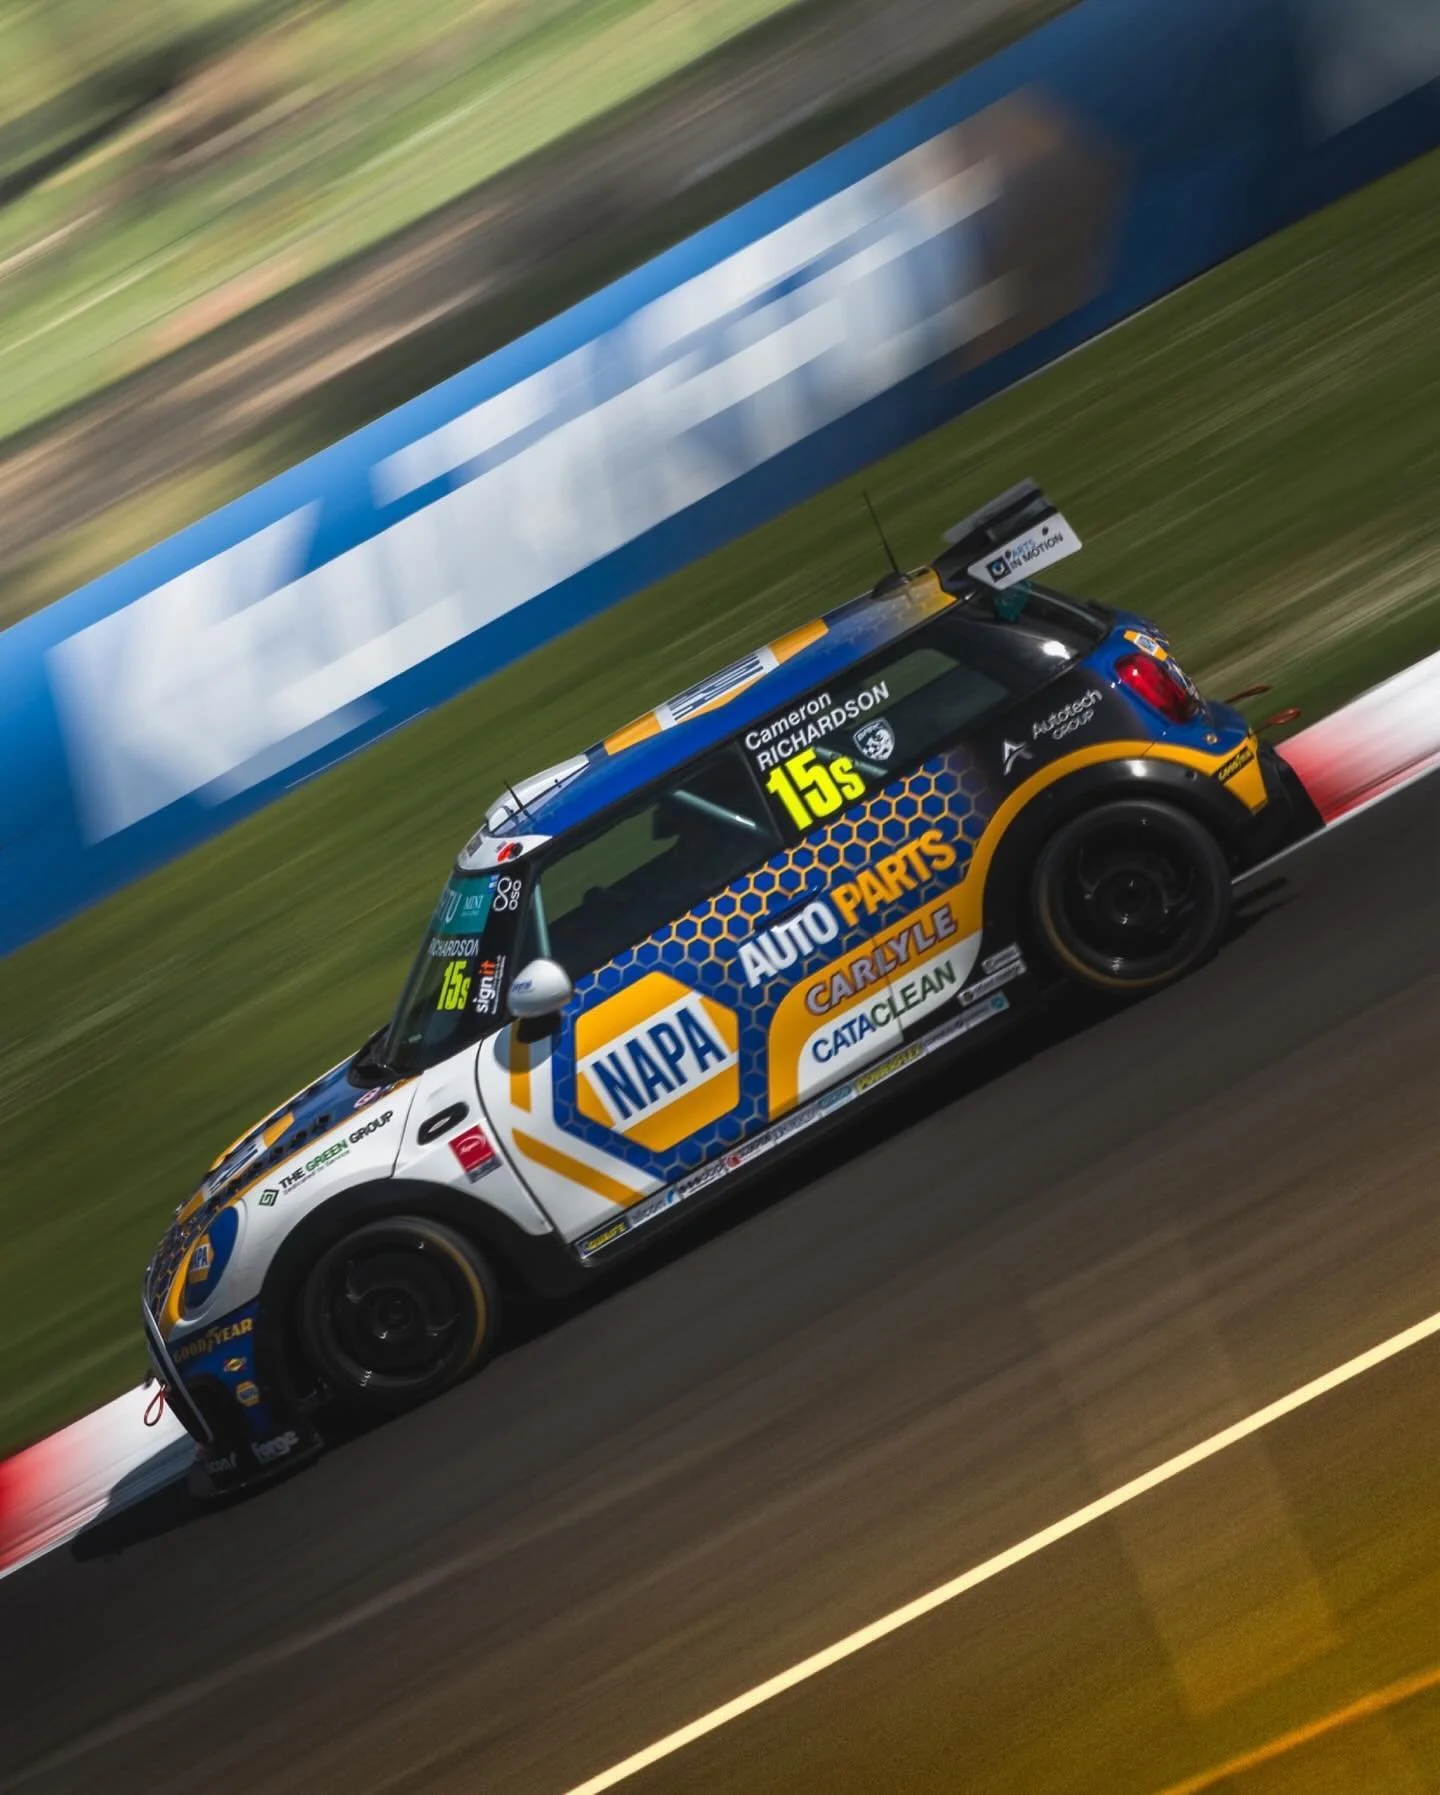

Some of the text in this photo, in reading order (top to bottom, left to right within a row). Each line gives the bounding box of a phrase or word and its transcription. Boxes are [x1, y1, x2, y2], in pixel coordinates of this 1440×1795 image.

[1022, 533, 1064, 563] MOTION
[745, 692, 832, 752] Cameron
[757, 682, 890, 771] RICHARDSON
[1032, 689, 1103, 741] Autotech
[1052, 708, 1094, 740] GROUP
[765, 746, 867, 831] 15s
[738, 829, 957, 988] AUTO PARTS
[437, 960, 472, 1010] 15s
[804, 904, 958, 1016] CARLYLE
[811, 961, 956, 1063] CATACLEAN
[592, 1005, 728, 1121] NAPA
[279, 1167, 305, 1189] THE
[305, 1139, 348, 1171] GREEN
[349, 1110, 393, 1144] GROUP
